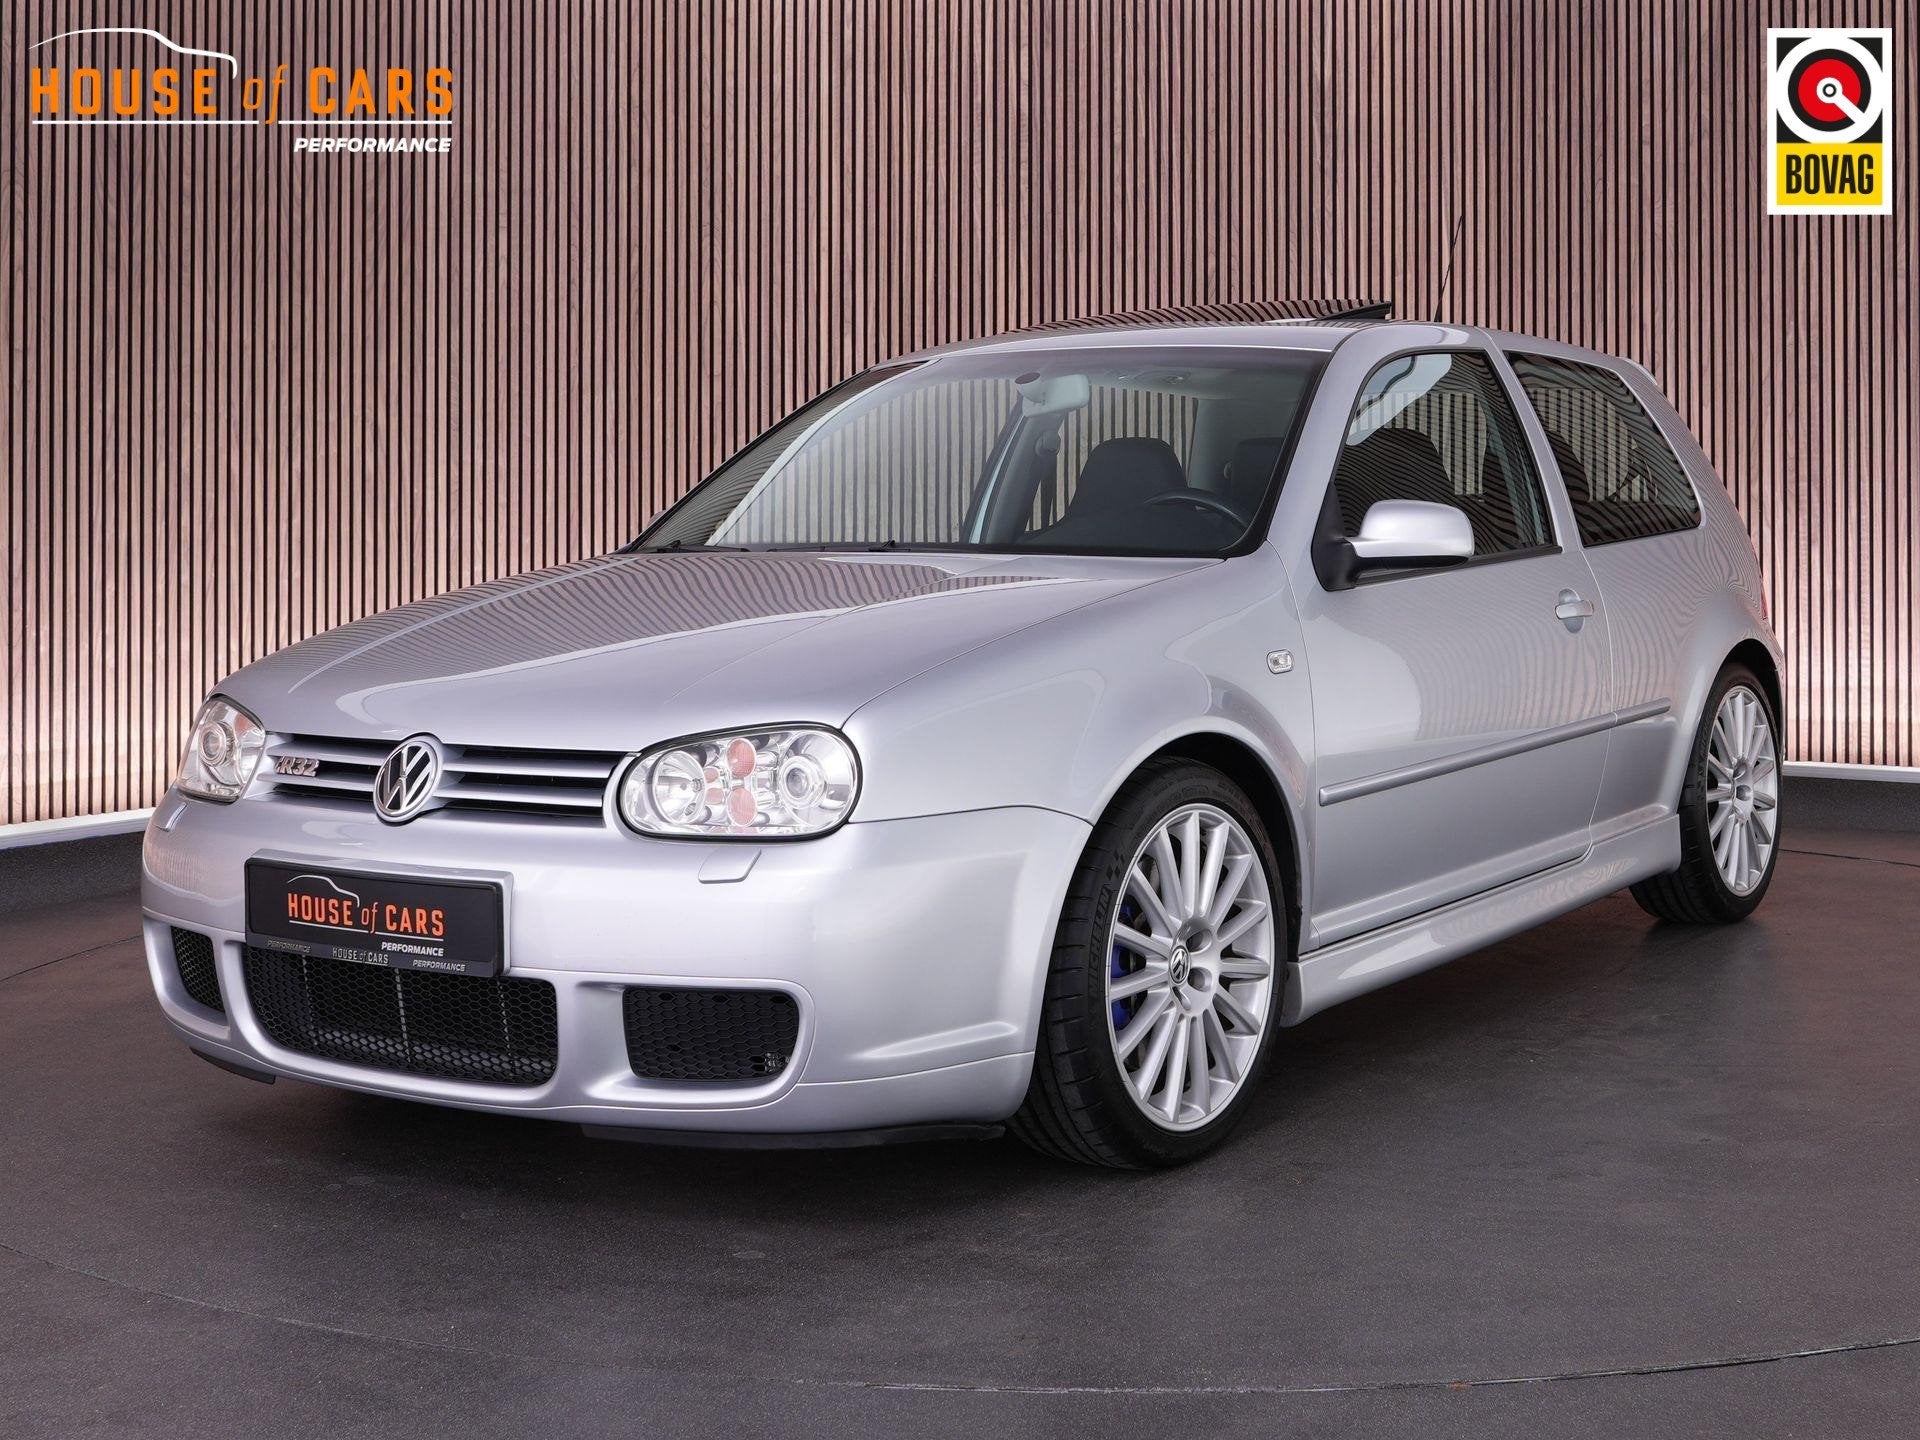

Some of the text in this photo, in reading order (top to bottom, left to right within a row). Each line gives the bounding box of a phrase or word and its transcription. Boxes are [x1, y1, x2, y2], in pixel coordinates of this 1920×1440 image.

[287, 892, 445, 937] HOUSE of CARS
[267, 939, 311, 953] PERFORMANCE
[381, 941, 444, 957] PERFORMANCE
[332, 947, 390, 965] HOUSE of CARS
[412, 959, 466, 972] PERFORMANCE
